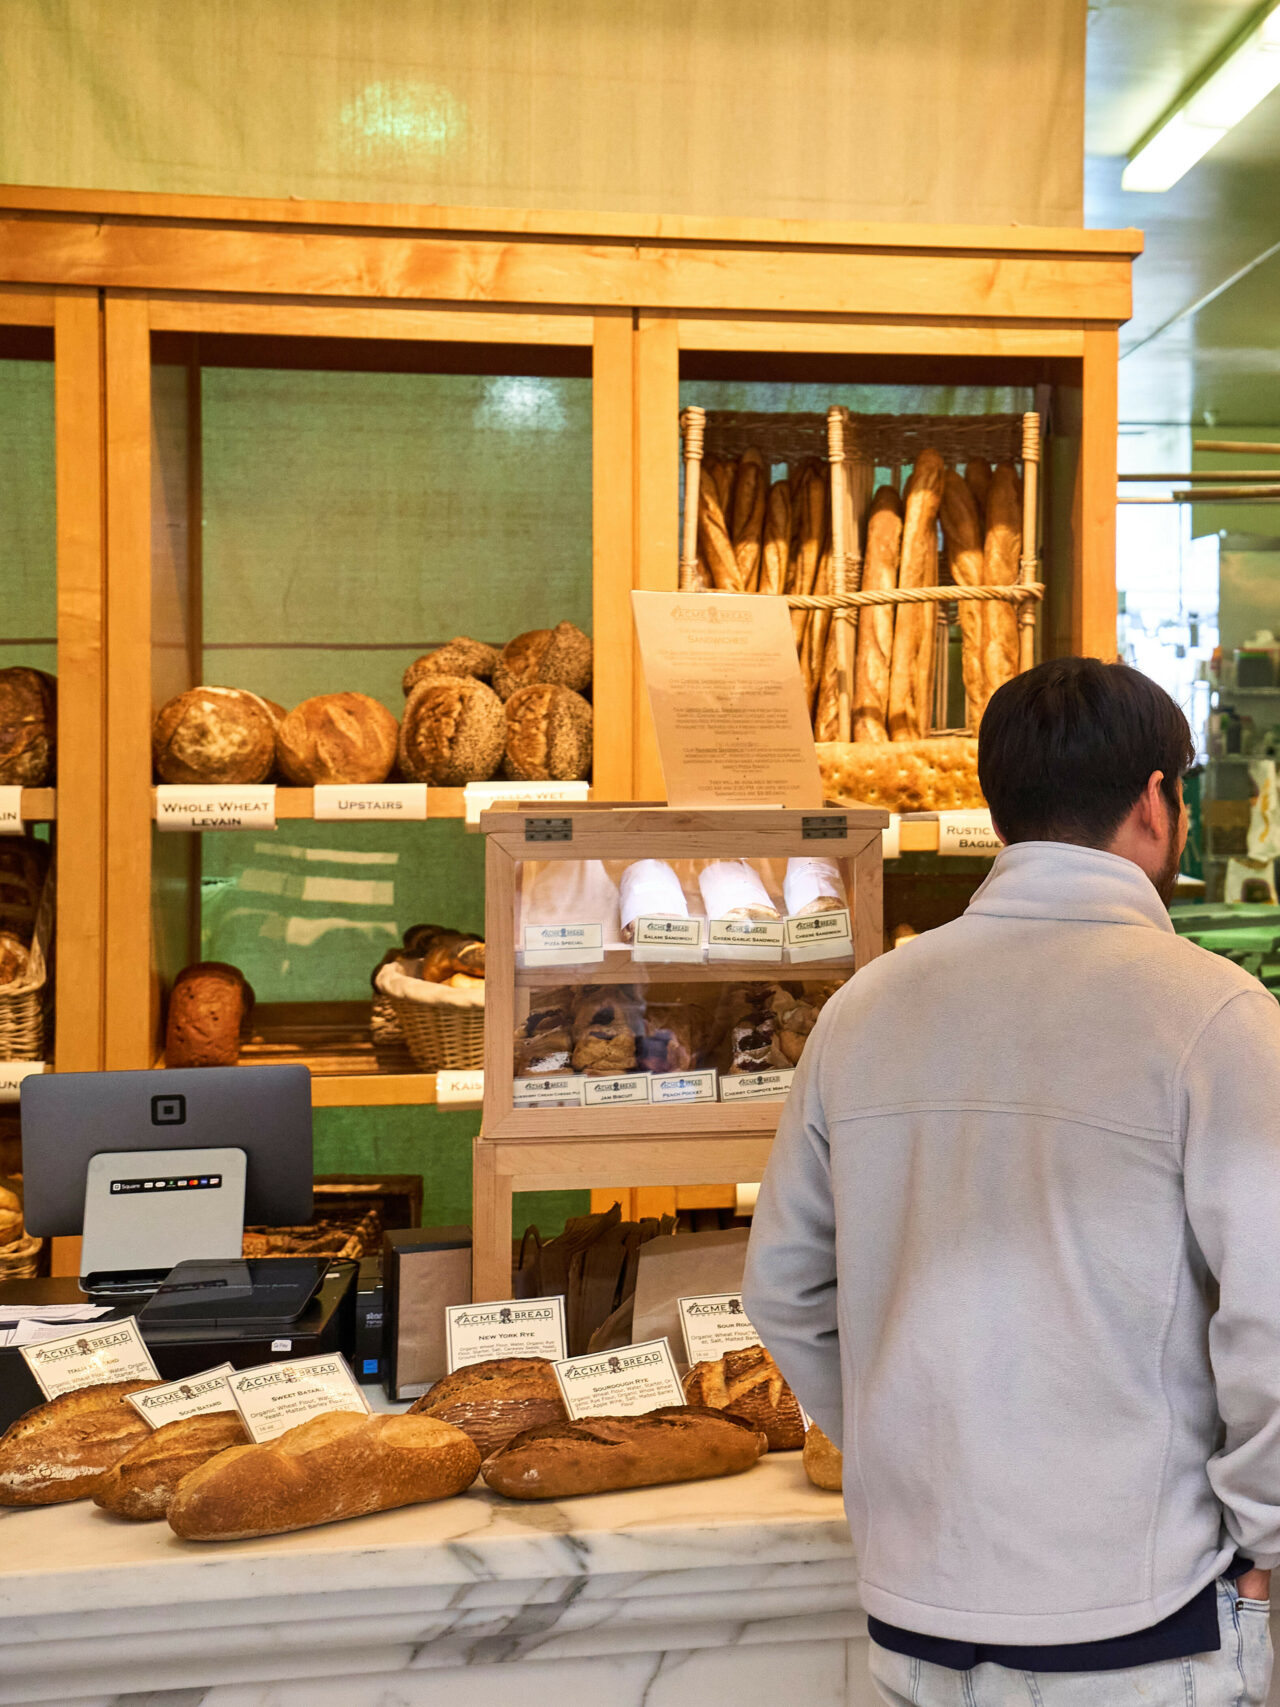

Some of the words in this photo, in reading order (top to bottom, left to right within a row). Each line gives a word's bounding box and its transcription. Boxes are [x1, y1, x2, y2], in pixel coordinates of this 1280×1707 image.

[162, 802, 215, 813] WHOLE
[218, 801, 270, 812] WHEAT
[337, 799, 404, 810] UPSTAIRS
[0, 811, 17, 820] IN
[191, 817, 242, 827] LEVAIN
[946, 825, 991, 836] RUSTIC
[815, 929, 842, 938] SANDWICH
[451, 1081, 482, 1091] KAIS
[121, 1183, 141, 1191] Square
[694, 1304, 728, 1314] ACME
[462, 1313, 498, 1324] ACME
[514, 1309, 552, 1319] BREAD
[43, 1346, 78, 1360] ACME
[92, 1332, 129, 1348] BREAD
[572, 1363, 607, 1378] ACME
[622, 1352, 660, 1367] BREAD
[245, 1373, 282, 1389] ACME
[299, 1364, 337, 1378] BREAD
[592, 1381, 634, 1393] SOURDOUGH
[634, 1377, 649, 1385] RYE
[149, 1391, 182, 1407] ACME
[271, 1392, 296, 1402] SWEET
[178, 1408, 197, 1417] SOUR
[196, 1401, 223, 1411] BATARD
